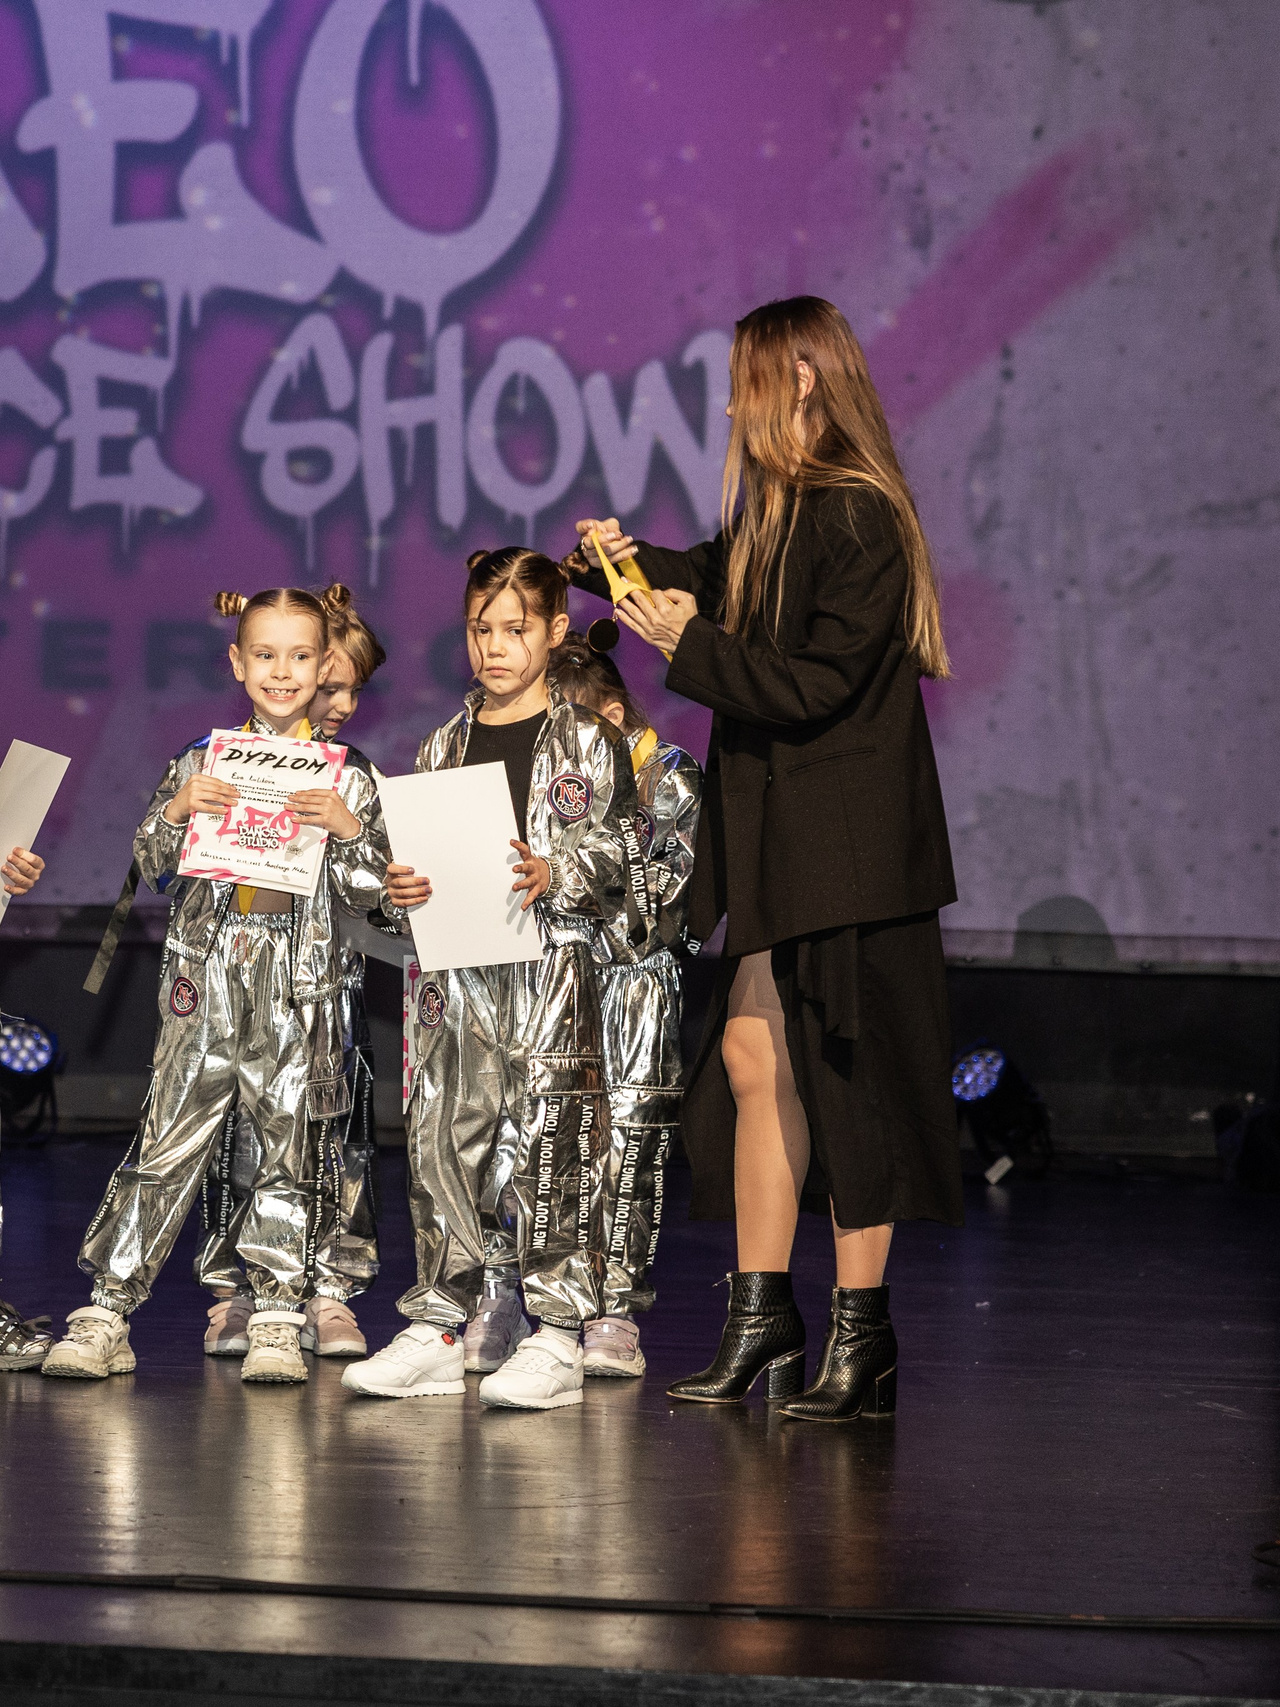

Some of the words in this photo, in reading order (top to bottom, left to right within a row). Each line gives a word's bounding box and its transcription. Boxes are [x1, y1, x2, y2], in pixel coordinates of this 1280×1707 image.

[242, 312, 734, 535] SHOW
[220, 748, 328, 776] DYPLOM
[238, 836, 279, 848] STUDIO
[239, 826, 280, 838] DANCE
[624, 831, 641, 861] TONG
[630, 864, 646, 892] TOUY
[224, 1110, 235, 1150] Fashion
[544, 1104, 560, 1132] TONG
[580, 1103, 594, 1132] TOUY
[539, 1135, 554, 1165] TOUY
[577, 1133, 591, 1162] TONG
[623, 1138, 641, 1166] TOUY
[220, 1151, 230, 1179] style
[579, 1165, 590, 1194] TOUY
[537, 1166, 553, 1196] TONG
[619, 1166, 636, 1194] TONG
[653, 1169, 664, 1197] TONG
[220, 1184, 230, 1225] Fashion
[534, 1199, 550, 1229] TOUY
[578, 1194, 589, 1224] TONG
[614, 1196, 631, 1225] TOUY
[652, 1197, 663, 1225] TOUY
[307, 1237, 316, 1267] style
[610, 1225, 627, 1254] TONG
[648, 1227, 660, 1255] TONG
